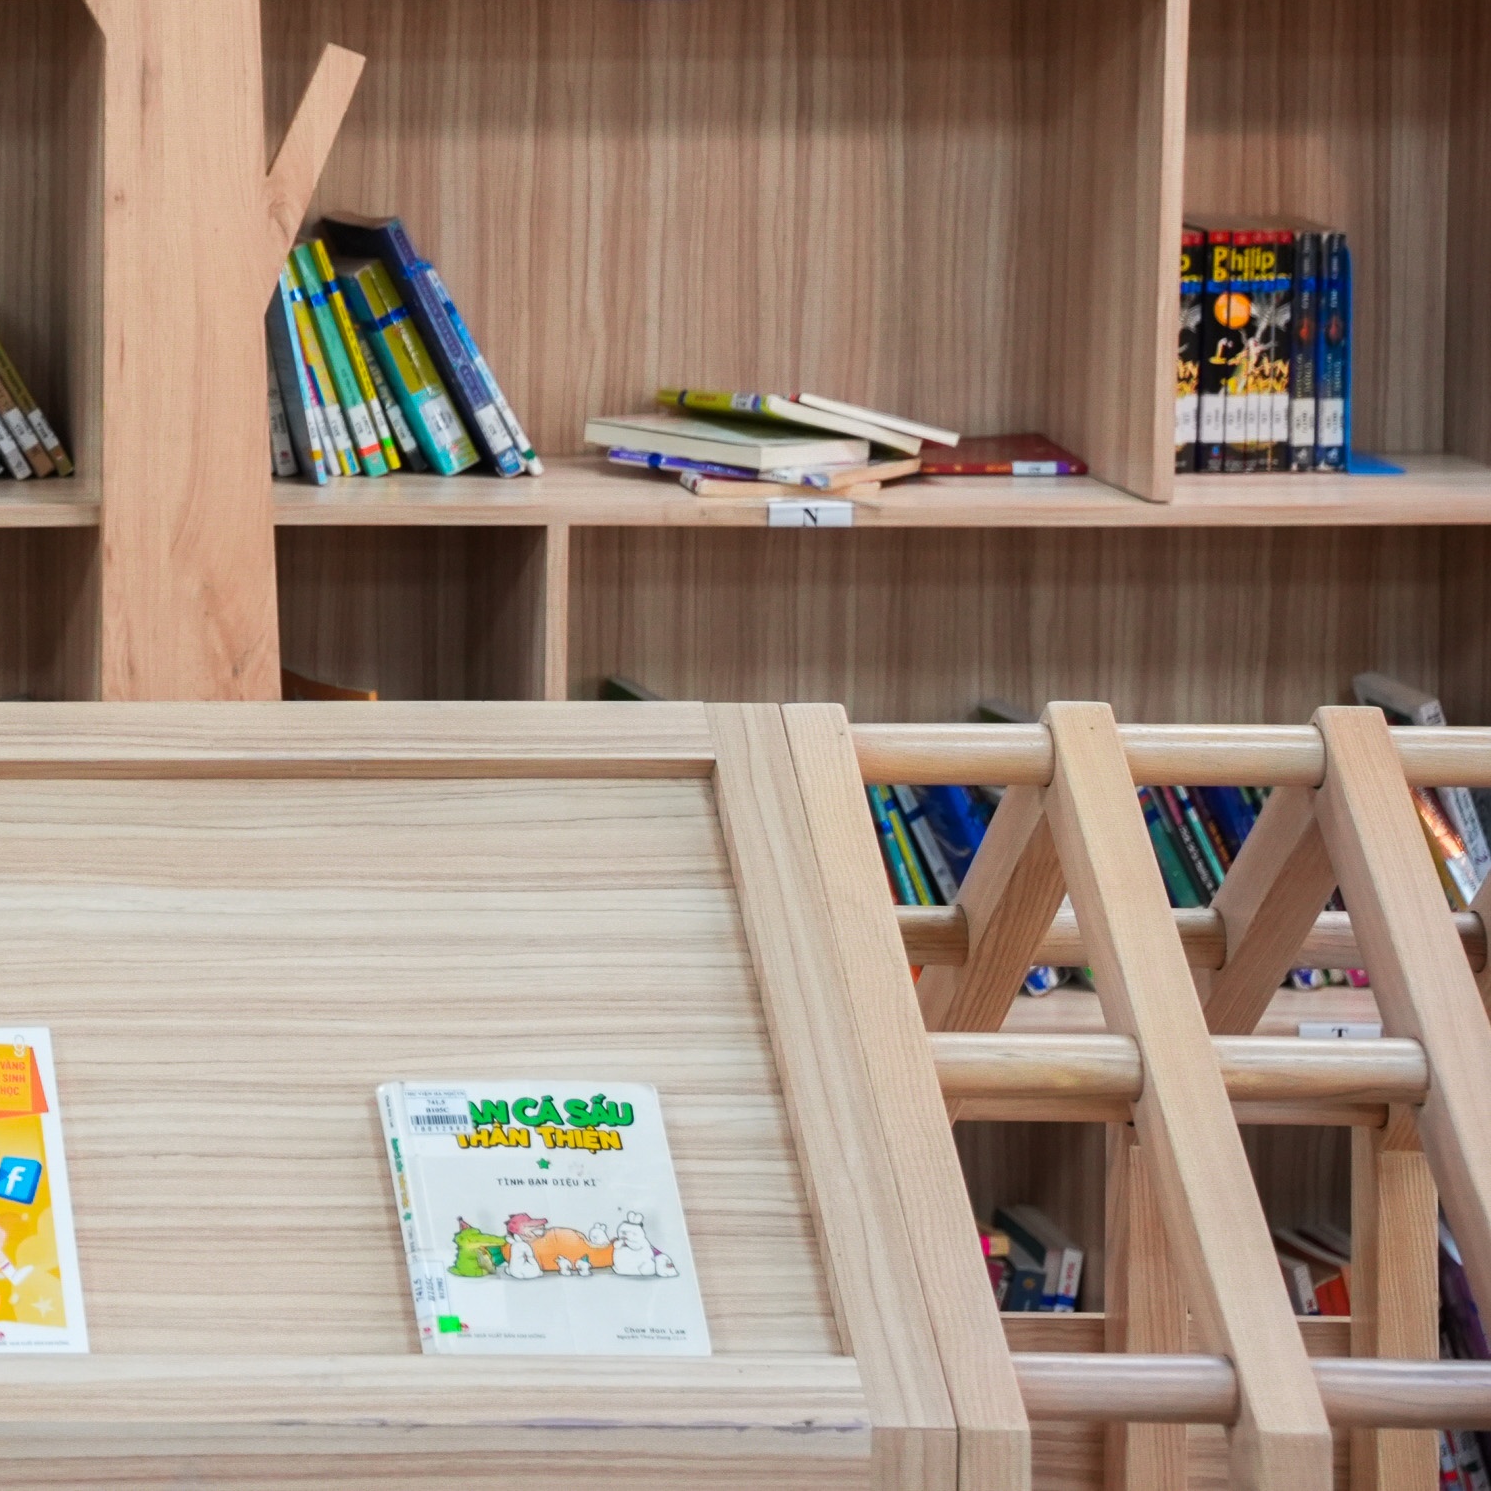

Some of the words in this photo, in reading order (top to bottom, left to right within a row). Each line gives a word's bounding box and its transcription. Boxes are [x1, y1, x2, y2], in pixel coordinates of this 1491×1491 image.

[802, 508, 819, 526] N
[2, 1072, 27, 1083] SINH
[0, 1085, 20, 1097] HỌC
[511, 1095, 564, 1126] CÁ
[566, 1093, 635, 1127] SẤU
[454, 1122, 531, 1149] THÂN
[535, 1126, 624, 1154] THIỆN
